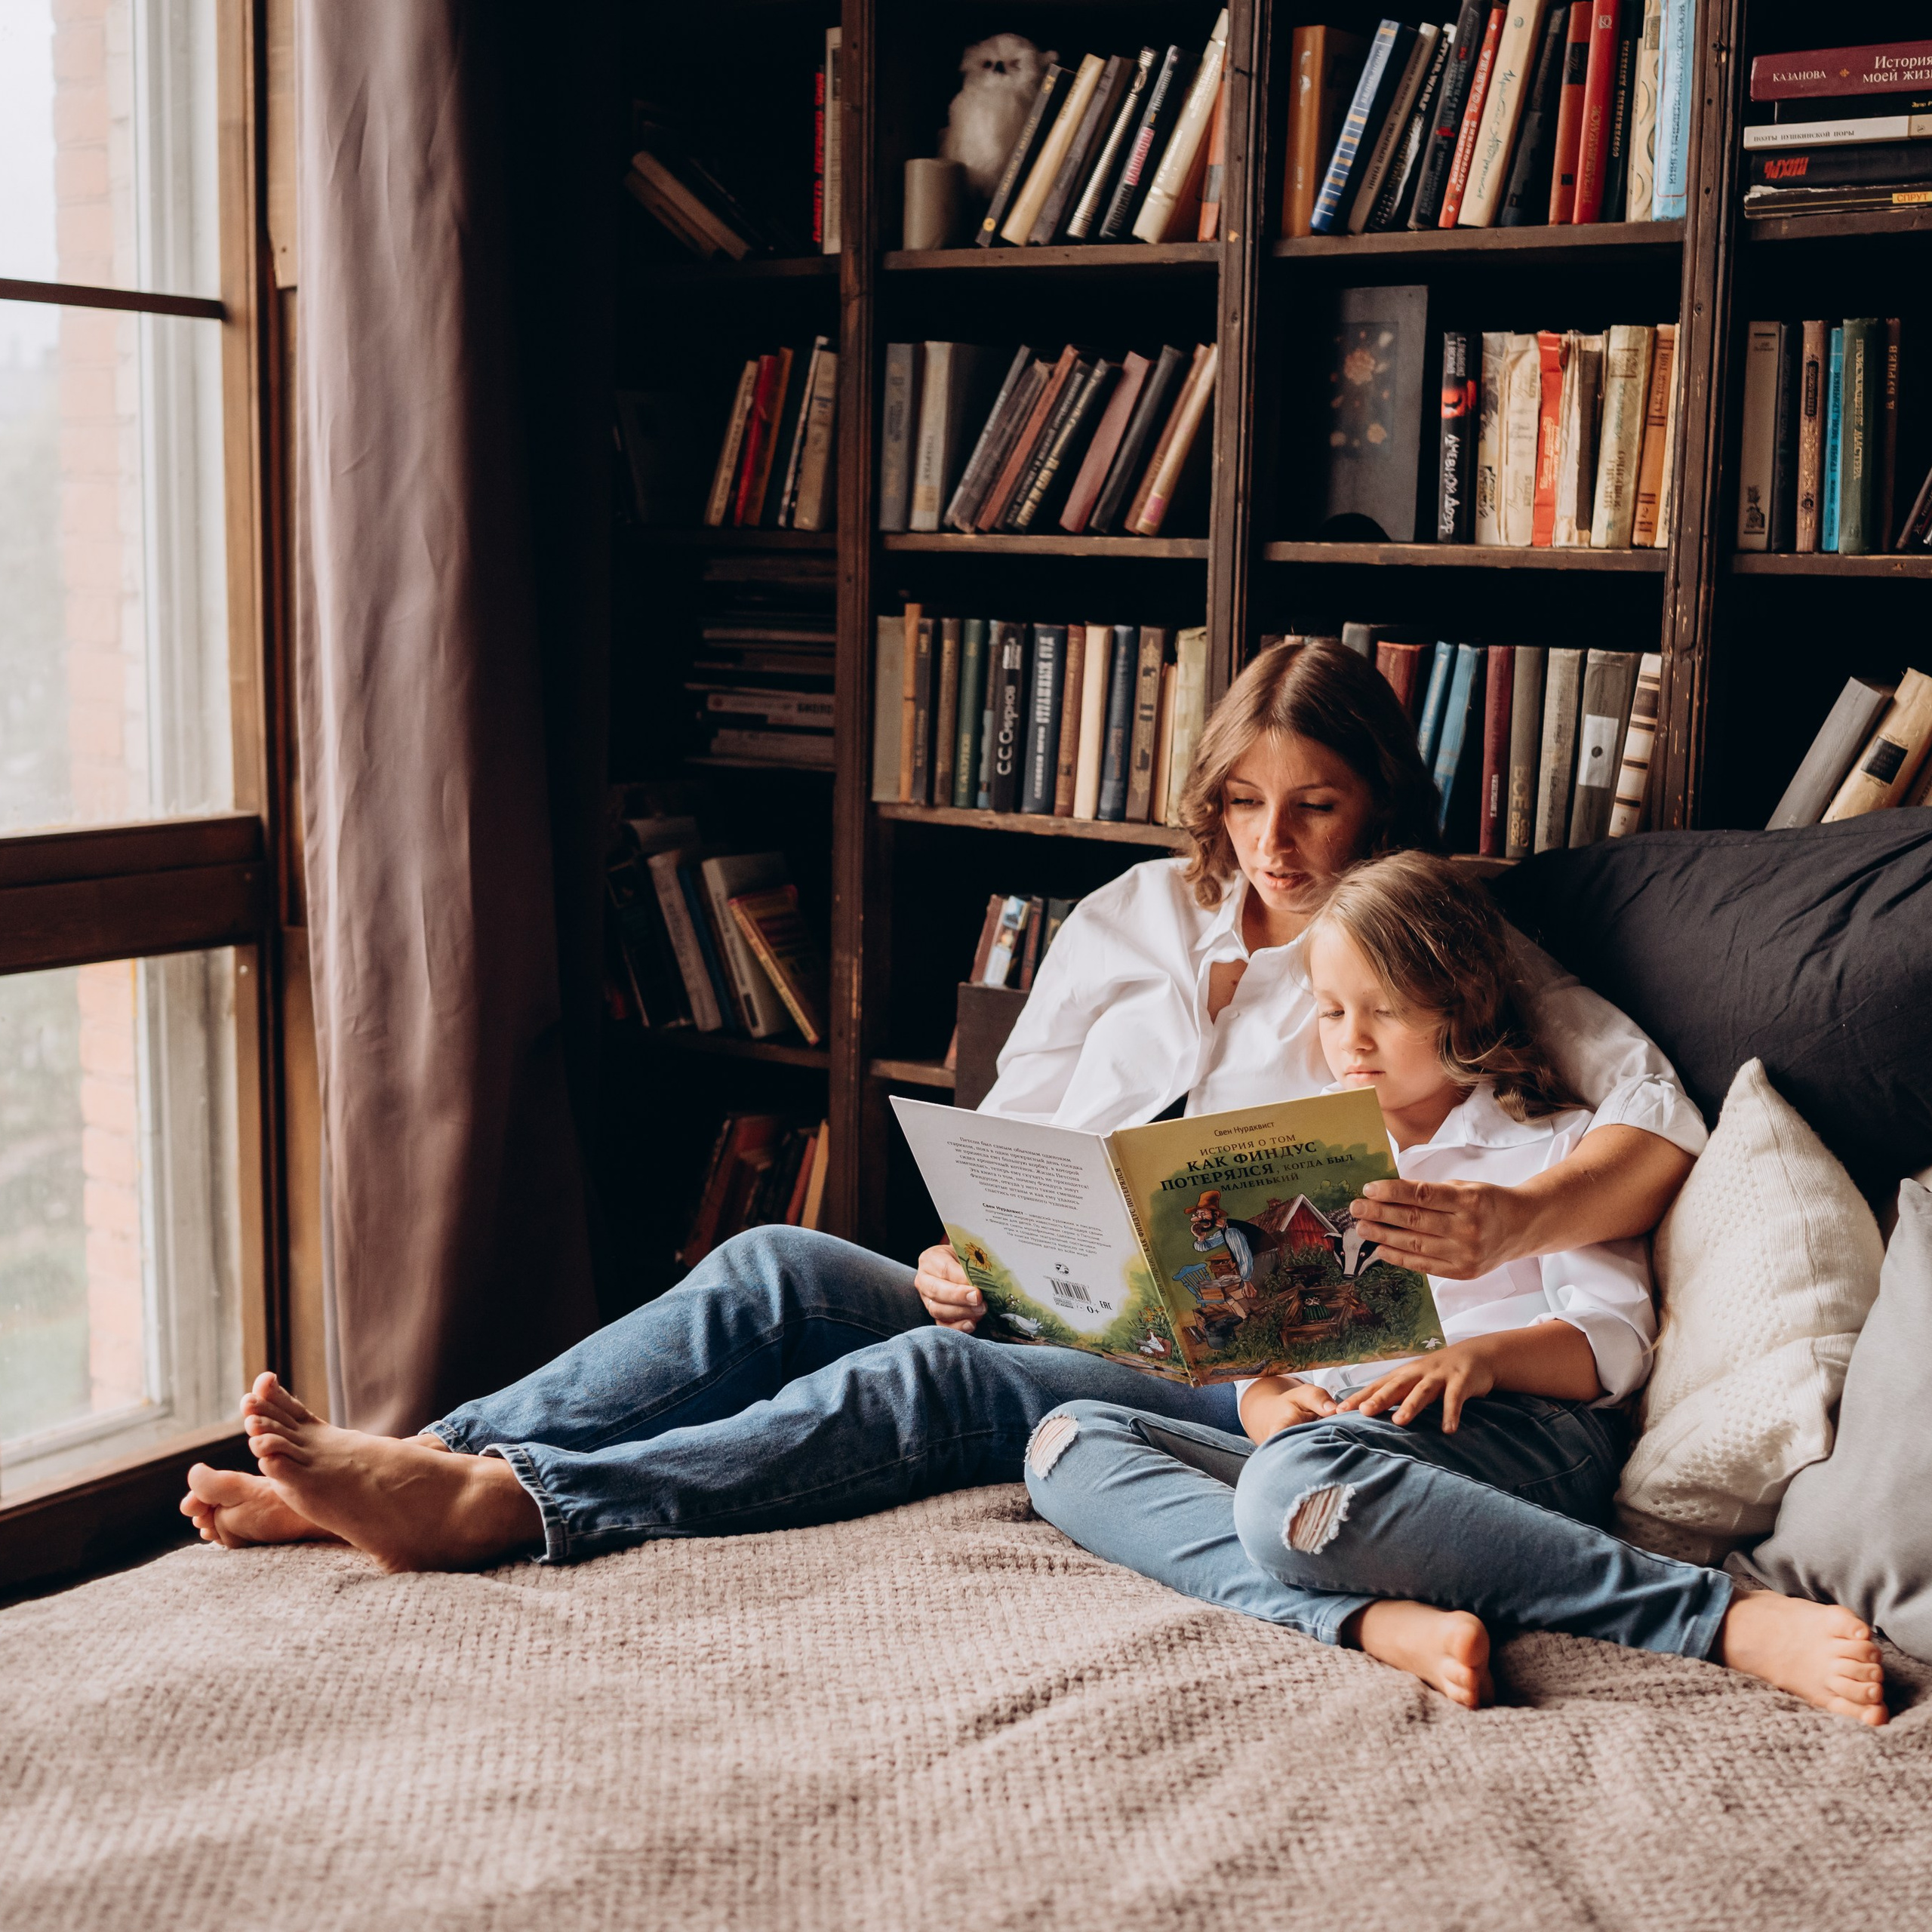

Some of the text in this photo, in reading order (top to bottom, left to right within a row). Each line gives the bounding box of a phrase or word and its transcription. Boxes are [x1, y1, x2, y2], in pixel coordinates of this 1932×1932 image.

[1875, 55, 1932, 69] История
[1417, 36, 1451, 111] STAR WARS
[1773, 70, 1826, 82] КАЗАНОВА
[1863, 68, 1932, 83] моей жиз
[1668, 148, 1678, 184] КНИГА
[1674, 4, 1687, 69] РАССКАЗОВ
[1781, 131, 1830, 141] ПУШКИНСКОЙ
[1450, 118, 1469, 183] КОНСТАНТИН
[1454, 119, 1477, 192] ПАУСТОВСКИЙ
[1897, 192, 1927, 202] СПРУТ
[1853, 429, 1863, 479] МАСТЕРА
[1512, 765, 1531, 809] ВСЕ
[1214, 1121, 1275, 1137] Свен Нурдквист
[958, 1137, 980, 1145] Петсон
[1012, 1147, 1041, 1156] обычным
[1041, 1152, 1071, 1162] одиноким
[1200, 1140, 1254, 1156] ИСТОРИЯ
[1269, 1134, 1296, 1145] ТОМ
[962, 1149, 989, 1158] принесла
[1001, 1156, 1028, 1166] большую
[1055, 1167, 1079, 1176] которой
[1009, 1152, 1045, 1164] прекрасный
[1060, 1162, 1083, 1171] соседка
[1186, 1141, 1317, 1173] КАК ФИНДУС
[1284, 1158, 1322, 1172] КОГДА
[1327, 1153, 1354, 1164] БЫЛ
[976, 1157, 1009, 1168] крошечный
[1035, 1168, 1055, 1177] Жизнь
[1055, 1173, 1080, 1181] Петсона
[989, 1165, 1010, 1174] теперь
[1021, 1172, 1044, 1180] скучать
[1052, 1178, 1090, 1189] приходится!
[1000, 1179, 1020, 1187] откуда
[1055, 1190, 1084, 1199] смешные
[1014, 1177, 1037, 1185] почему
[1036, 1180, 1062, 1189] Финдуса
[1114, 1166, 1134, 1208] ПОТЕРЯЛСЯ
[1220, 1173, 1300, 1192] МАЛЕНЬКИЙ
[995, 1205, 1023, 1214] Нурдквист
[1056, 1195, 1080, 1204] удалось
[1129, 1208, 1145, 1238] ФИНДУС
[1140, 1238, 1150, 1253] КАК
[1087, 1306, 1100, 1314] 0+
